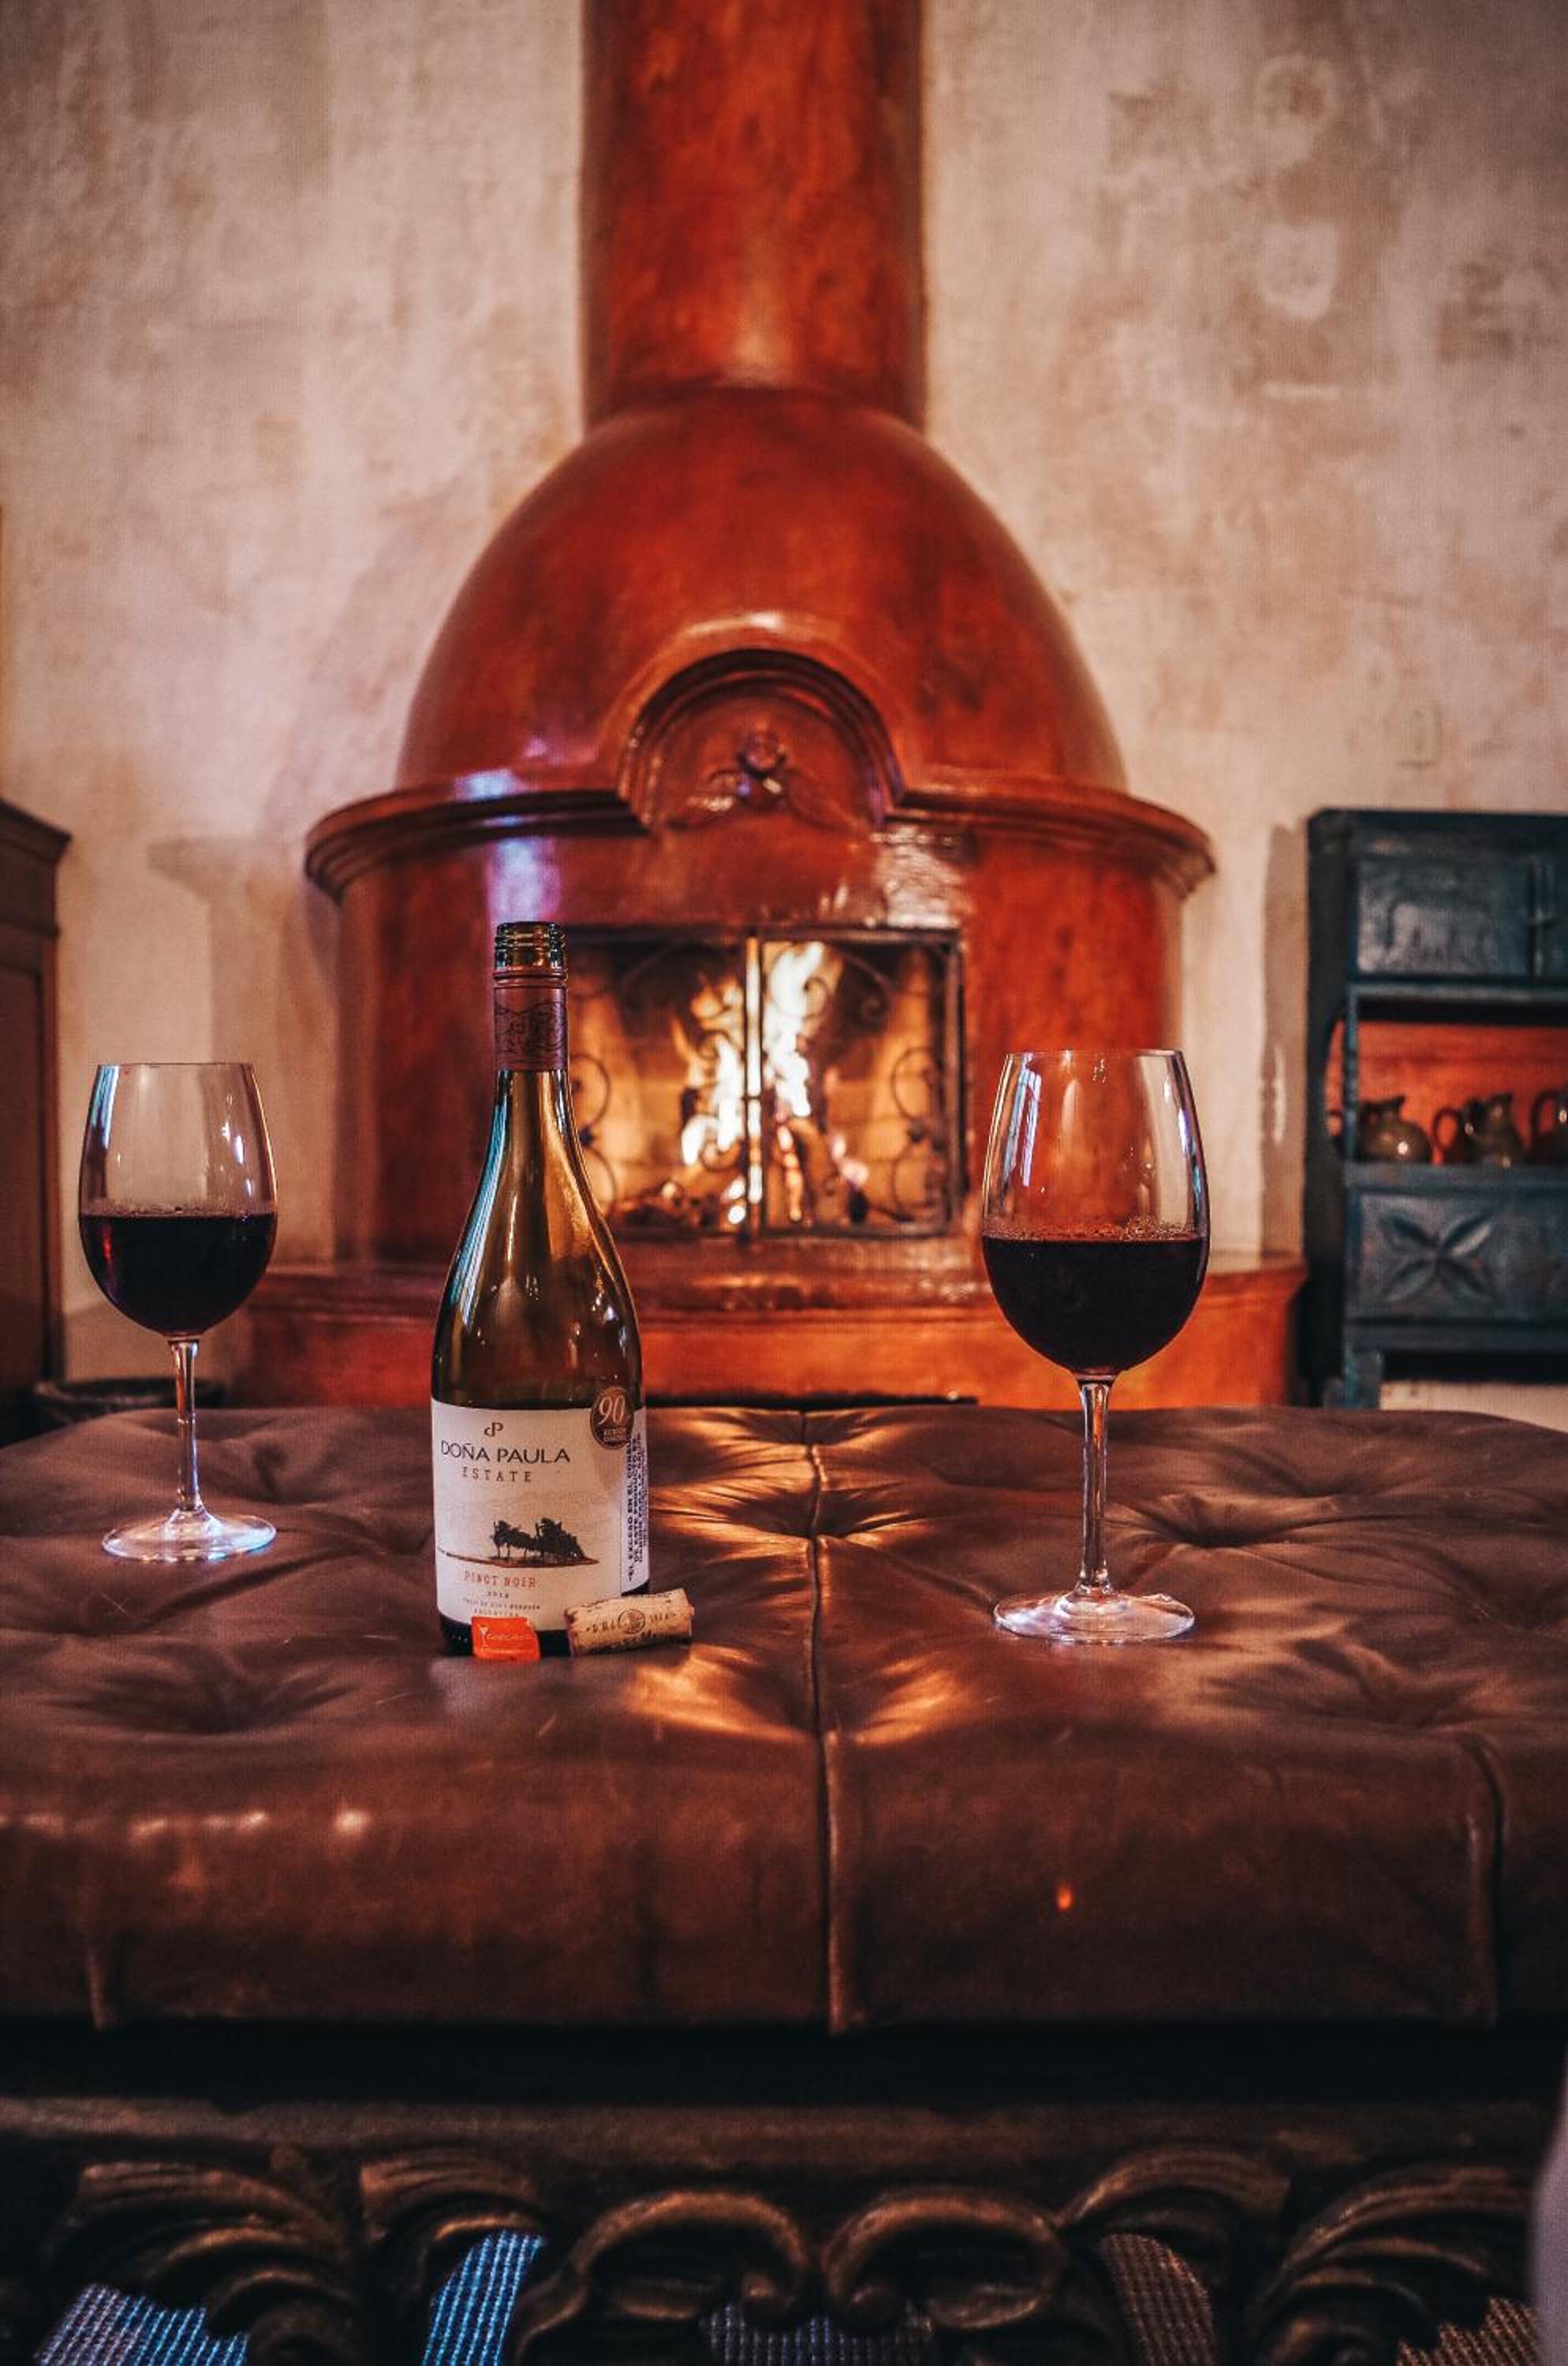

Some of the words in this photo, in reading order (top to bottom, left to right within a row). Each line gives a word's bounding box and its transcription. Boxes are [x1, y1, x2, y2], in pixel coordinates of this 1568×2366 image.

[599, 1395, 625, 1424] 90
[440, 1439, 490, 1461] DOÑA
[496, 1448, 571, 1464] PAULA
[462, 1466, 532, 1483] ESTATE
[465, 1570, 498, 1585] PINOT
[505, 1577, 536, 1588] NOIR
